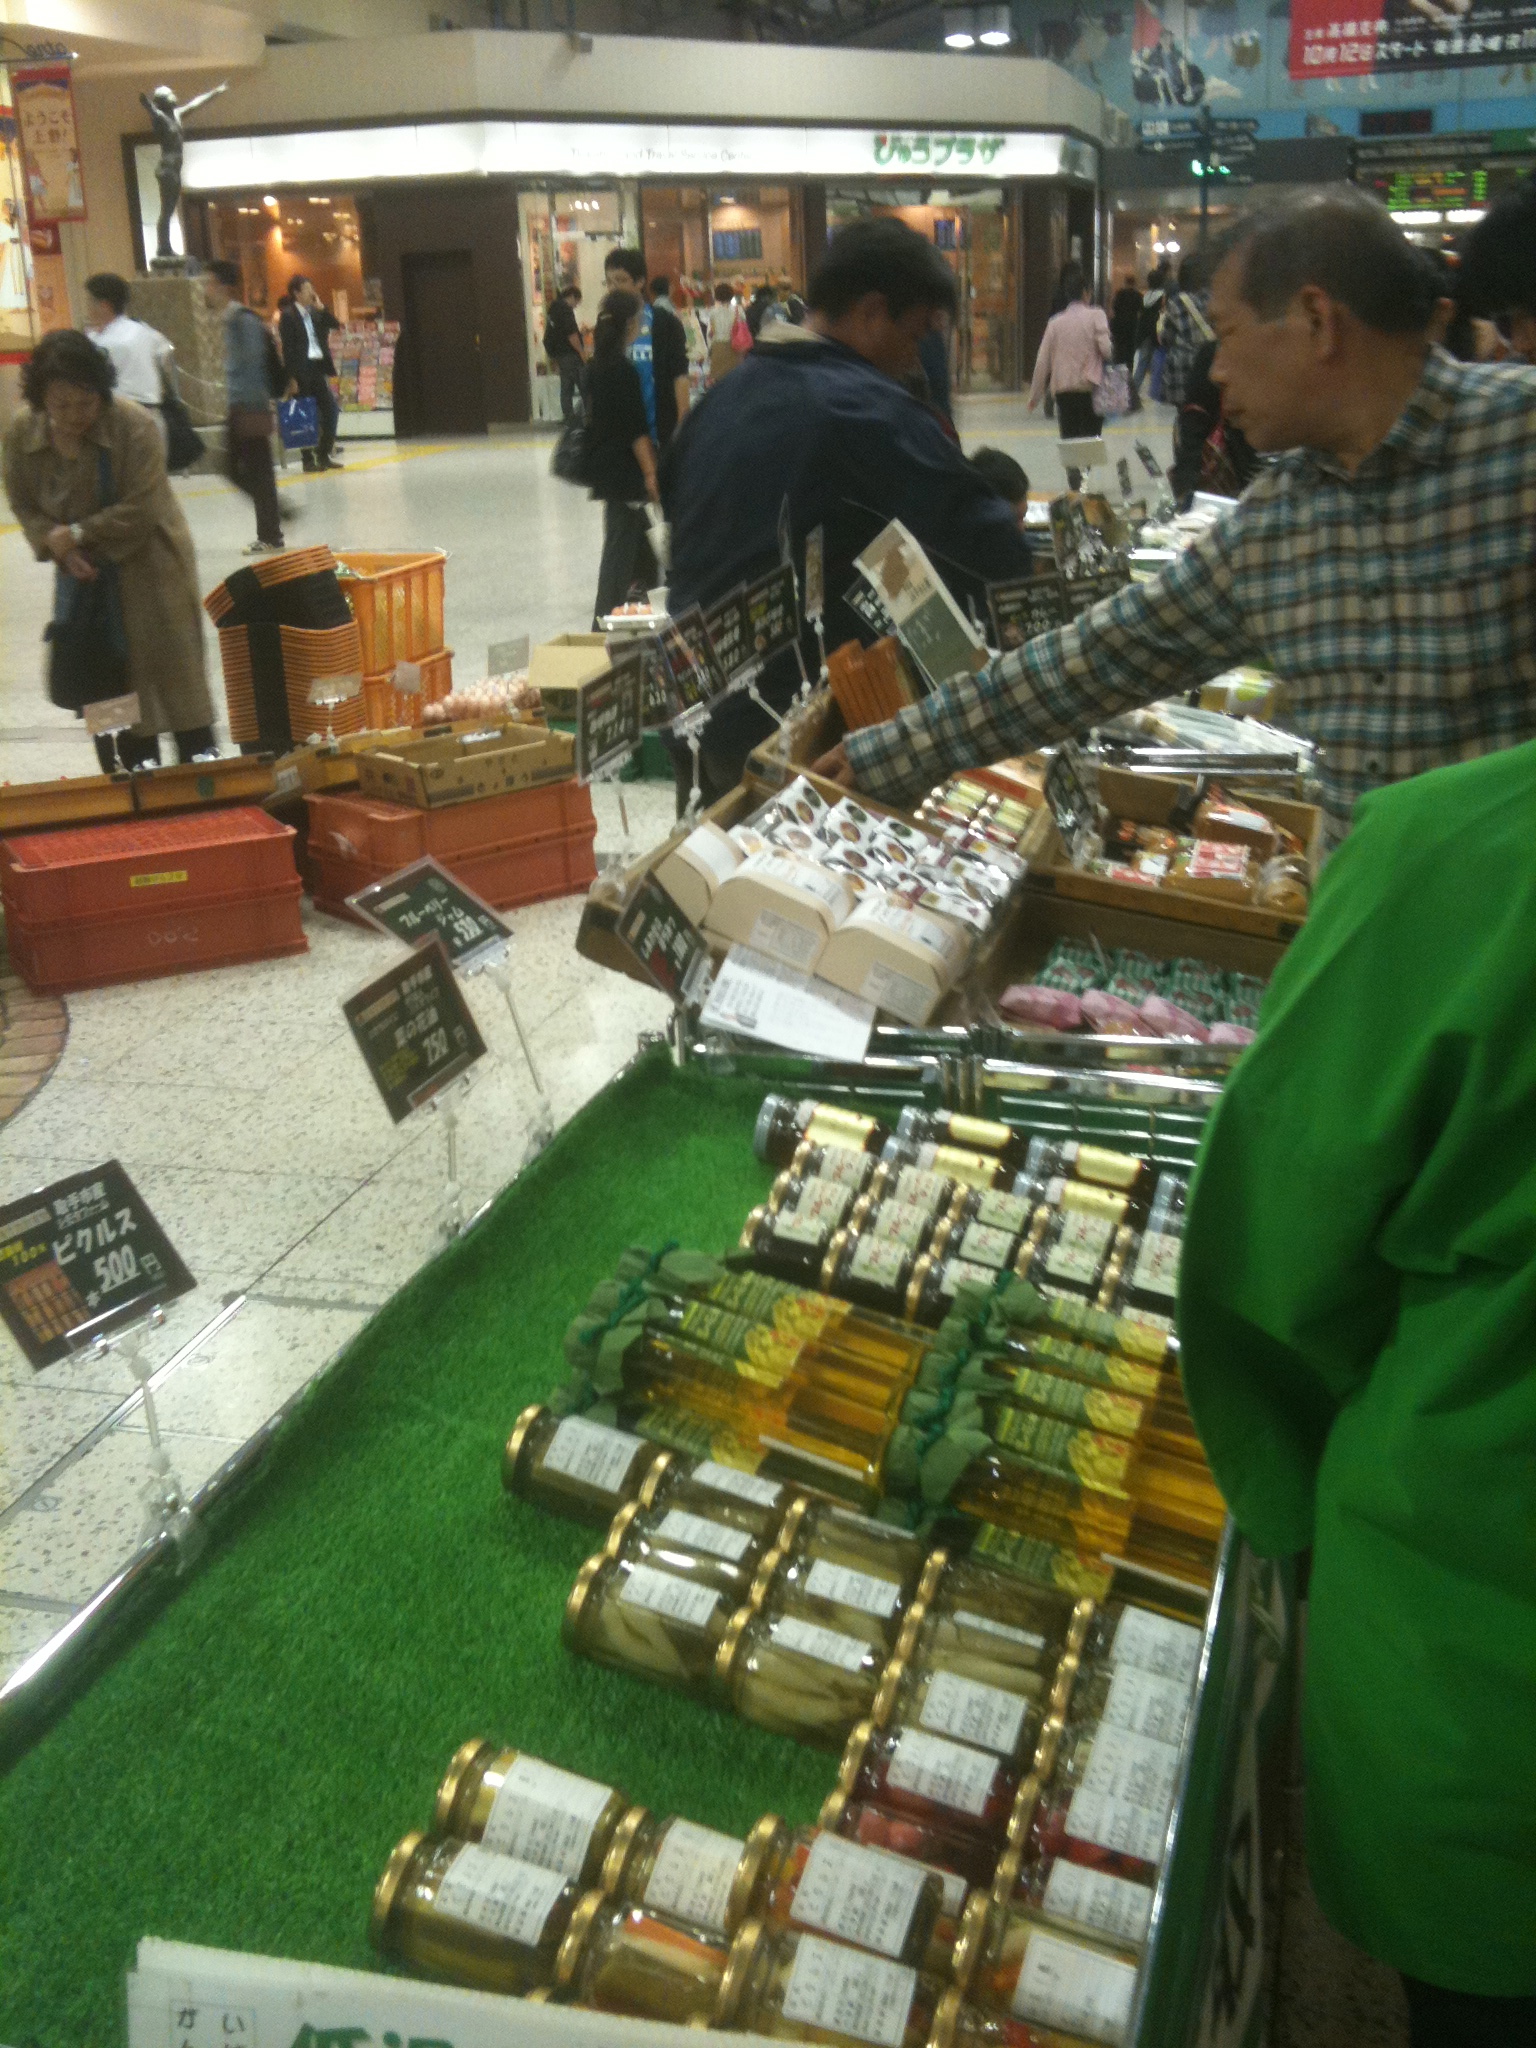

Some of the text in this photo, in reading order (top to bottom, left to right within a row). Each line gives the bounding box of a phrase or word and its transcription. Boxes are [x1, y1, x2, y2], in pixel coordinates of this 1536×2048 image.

[52, 1206, 137, 1266] ピクルス
[92, 1244, 139, 1294] 500
[140, 1252, 162, 1275] 円
